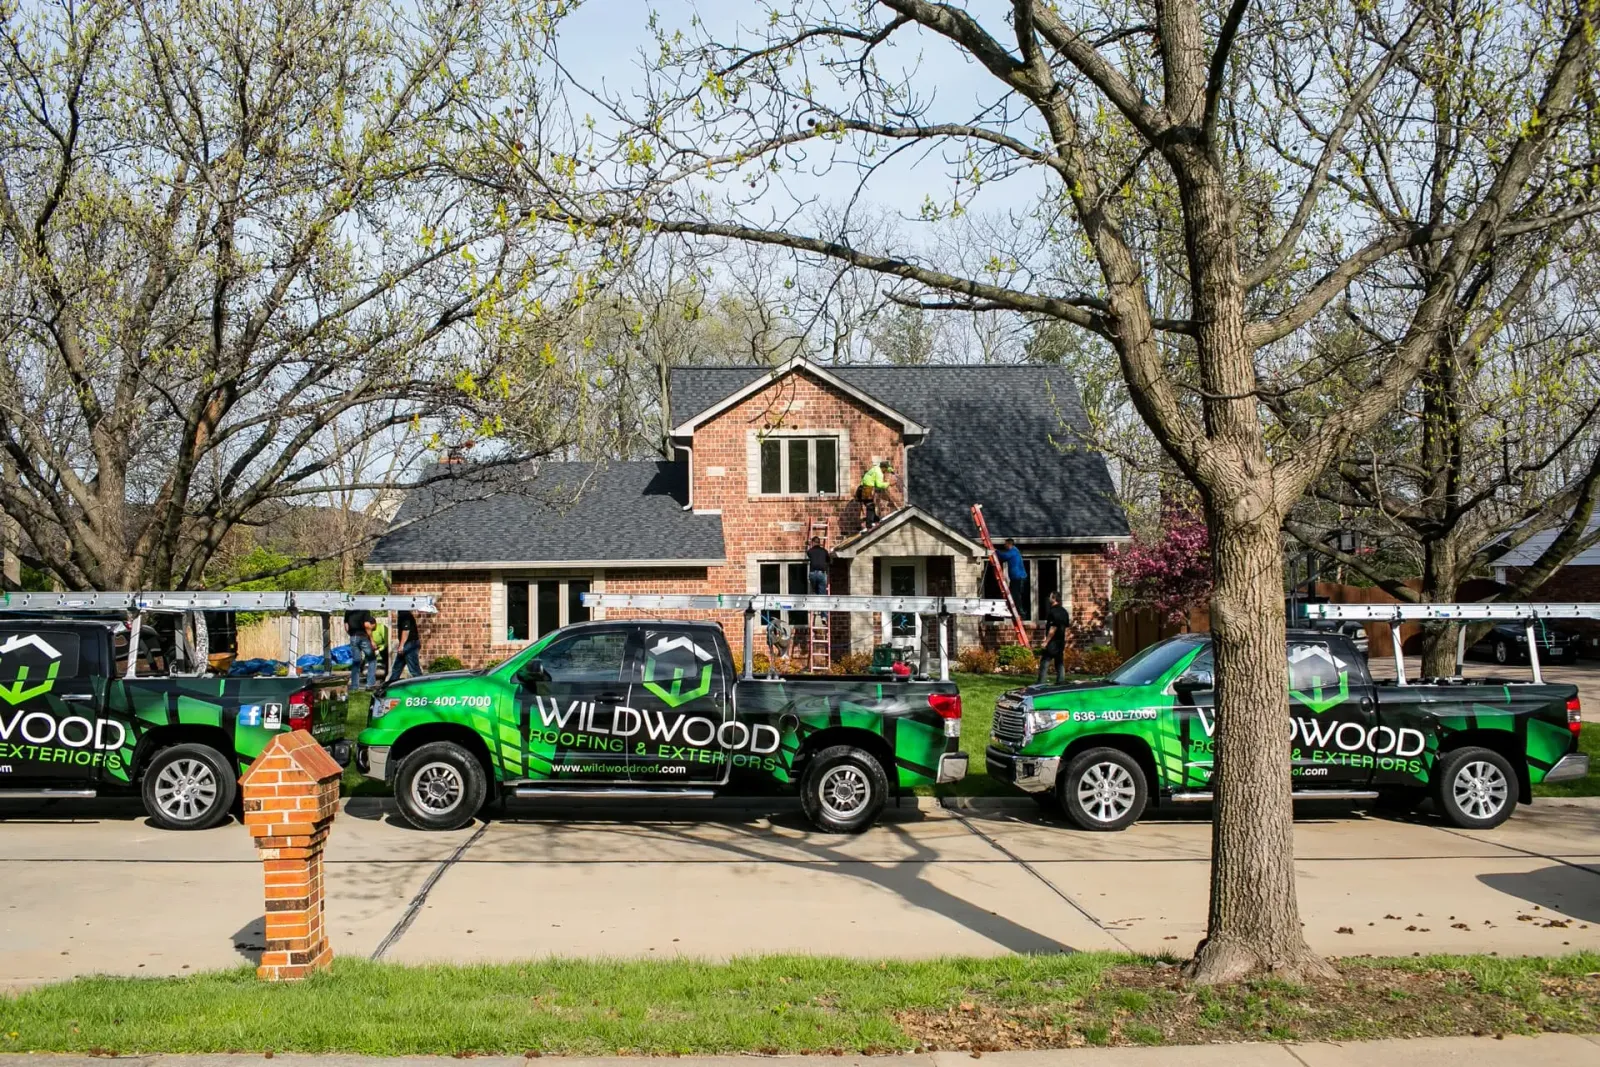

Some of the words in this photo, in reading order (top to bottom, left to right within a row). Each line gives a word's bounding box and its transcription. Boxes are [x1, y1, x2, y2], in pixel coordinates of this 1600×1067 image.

[405, 696, 492, 707] 636-400-7000
[1073, 708, 1157, 721] 636-400-7000
[536, 695, 780, 753] WILDWOOD
[529, 729, 624, 752] ROOFING
[635, 742, 646, 756] &
[658, 744, 776, 771] EXTERORS
[1291, 748, 1302, 761] &
[551, 764, 686, 775] www.wildwoodroof.com
